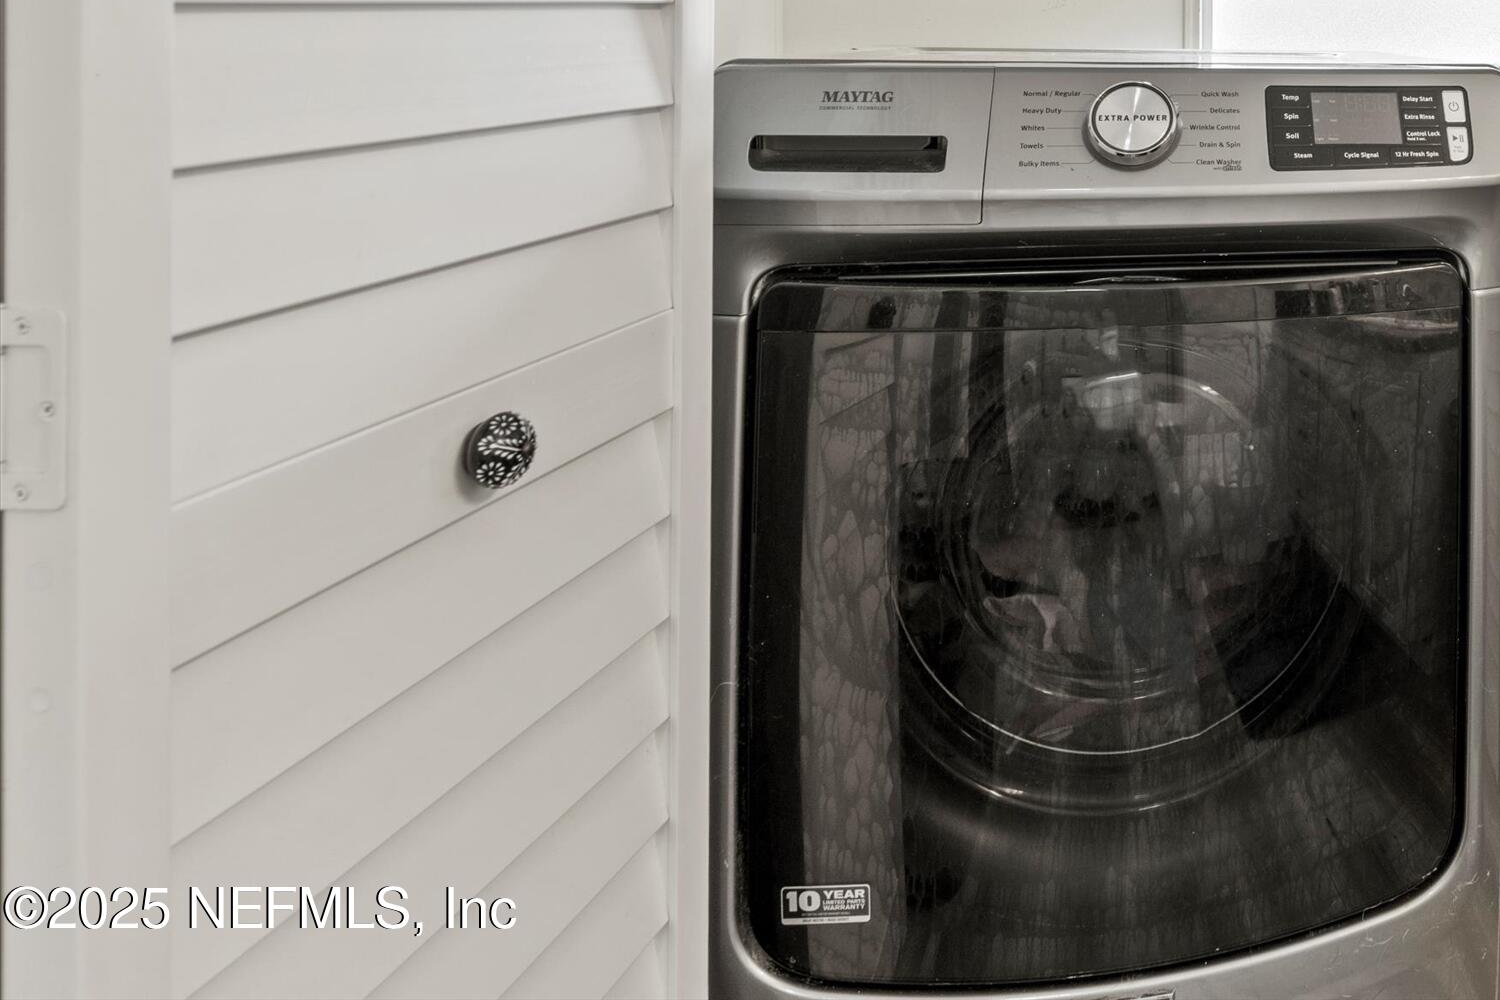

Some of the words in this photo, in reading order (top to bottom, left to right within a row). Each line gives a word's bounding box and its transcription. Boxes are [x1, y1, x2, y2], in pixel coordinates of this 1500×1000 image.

[822, 90, 894, 103] MAYTAG
[1281, 94, 1300, 102] Temp
[1098, 114, 1130, 122] EXTRA
[1133, 114, 1168, 122] POWER
[1344, 151, 1360, 159] Cycle
[1360, 151, 1380, 159] Signal
[1018, 160, 1040, 168] Bulky
[785, 890, 821, 913] 10
[823, 888, 865, 900] YEAR
[823, 903, 865, 911] WARRANTY
